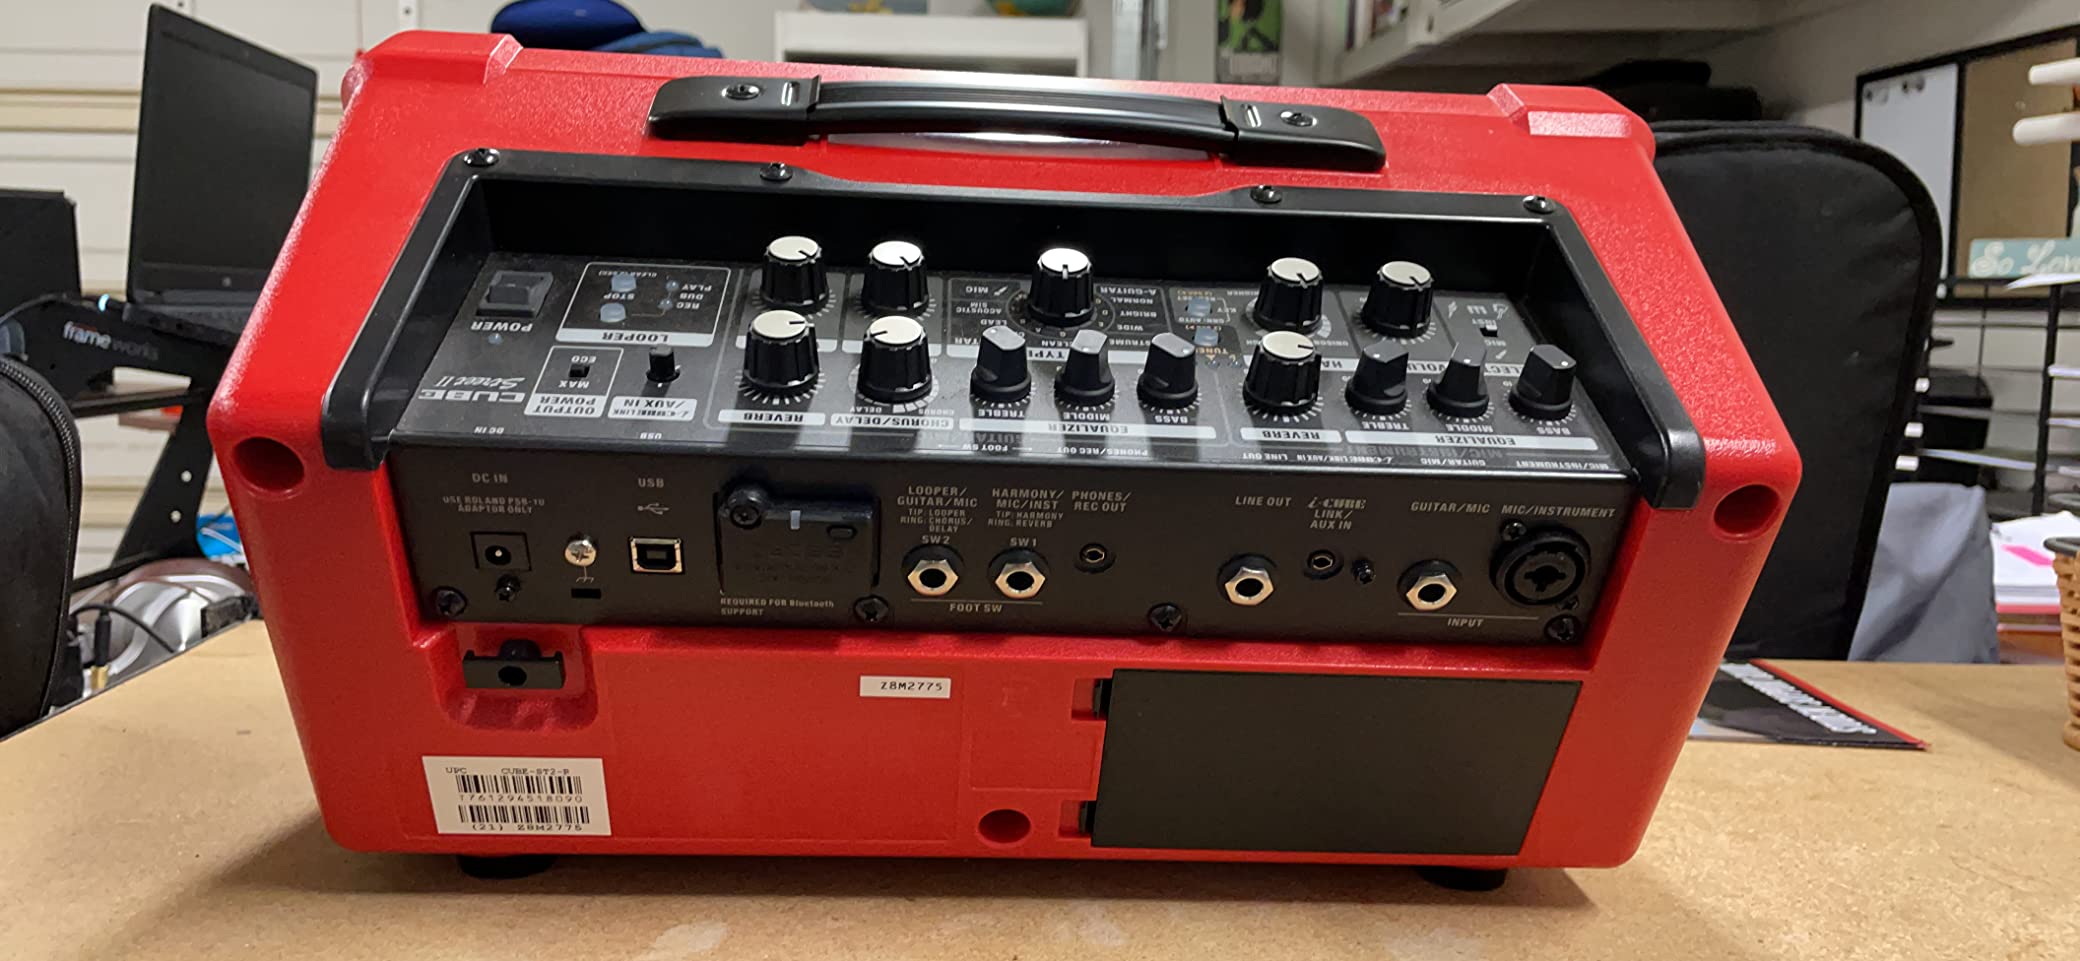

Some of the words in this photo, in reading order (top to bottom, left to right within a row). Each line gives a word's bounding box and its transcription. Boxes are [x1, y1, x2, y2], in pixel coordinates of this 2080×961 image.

[681, 283, 713, 292] PLAY
[965, 286, 989, 294] MIC
[1101, 287, 1157, 295] A-GUITAR
[603, 292, 636, 300] STOP
[679, 292, 704, 300] DUB
[676, 301, 700, 310] REC
[955, 307, 1002, 315] ACOUSTIC
[470, 321, 534, 332] POWER
[602, 332, 670, 343] LOOPER
[571, 355, 597, 364] ECO
[454, 377, 525, 390] Street
[558, 380, 590, 389] MAX
[419, 389, 525, 402] CUBE
[540, 396, 597, 406] POWER
[623, 400, 641, 408] IN
[533, 404, 596, 416] OUTPUT
[978, 408, 1025, 418] TREBLE
[743, 412, 804, 423] REVERB
[1062, 411, 1111, 421] MIDDLE
[1155, 415, 1189, 424] BASS
[835, 416, 949, 428] CHORUS/DELAY
[1361, 421, 1410, 431] TREBLE
[474, 426, 488, 435] IN
[490, 427, 505, 436] DC
[1047, 423, 1129, 435] EQUALIZER
[1446, 424, 1494, 434] MIDDLE
[1536, 427, 1572, 436] BASS
[640, 432, 662, 440] USB
[1261, 430, 1320, 440] REVERB
[1435, 434, 1517, 446] EQUALIZER
[962, 443, 980, 451] SW
[981, 444, 1008, 452] FOOT
[1057, 446, 1078, 454] OUT
[1080, 446, 1148, 456] PHONES/REC
[1241, 452, 1262, 460] OUT
[1264, 453, 1287, 462] LINE
[1420, 458, 1486, 467] GUITAR/MIC
[1516, 460, 1609, 470] MIC/INSTRUMENT
[472, 472, 490, 484] DC
[493, 472, 509, 484] IN
[638, 478, 664, 489] USB
[908, 485, 967, 497] LOOPER/
[992, 488, 1065, 500] HARMONY/
[1071, 490, 1132, 502] PHONES/
[464, 496, 505, 506] ROLAND
[896, 496, 978, 508] GUITAR/MIC
[996, 499, 1059, 511] MIC/INST
[1235, 495, 1265, 507] LINE
[1267, 496, 1292, 508] OUT
[458, 504, 505, 513] ADAPTOR
[507, 504, 533, 515] ONLY
[1073, 501, 1098, 512] REC
[1101, 501, 1127, 513] OUT
[1410, 500, 1490, 514] GUITAR/MIC
[1501, 504, 1617, 518] MIC/INSTRUMENT
[928, 508, 966, 517] LOOPER
[1016, 511, 1064, 520] HARMONY
[1314, 509, 1353, 519] LINK/
[928, 516, 973, 526] CHORUS/
[1016, 519, 1053, 528] REVERB
[1309, 519, 1335, 529] AUX
[1338, 520, 1352, 530] IN
[928, 525, 959, 533] DELAY
[720, 597, 767, 607] REQUIRED
[768, 598, 787, 607] FOR
[789, 599, 835, 609] Bluetooth
[949, 603, 980, 612] FOOT
[983, 603, 1003, 613] SW
[720, 607, 764, 617] SUPPORT
[1447, 617, 1484, 628] INPUT
[880, 681, 943, 691] Z8M2775
[445, 766, 468, 775] UPC
[472, 824, 503, 832] (21)
